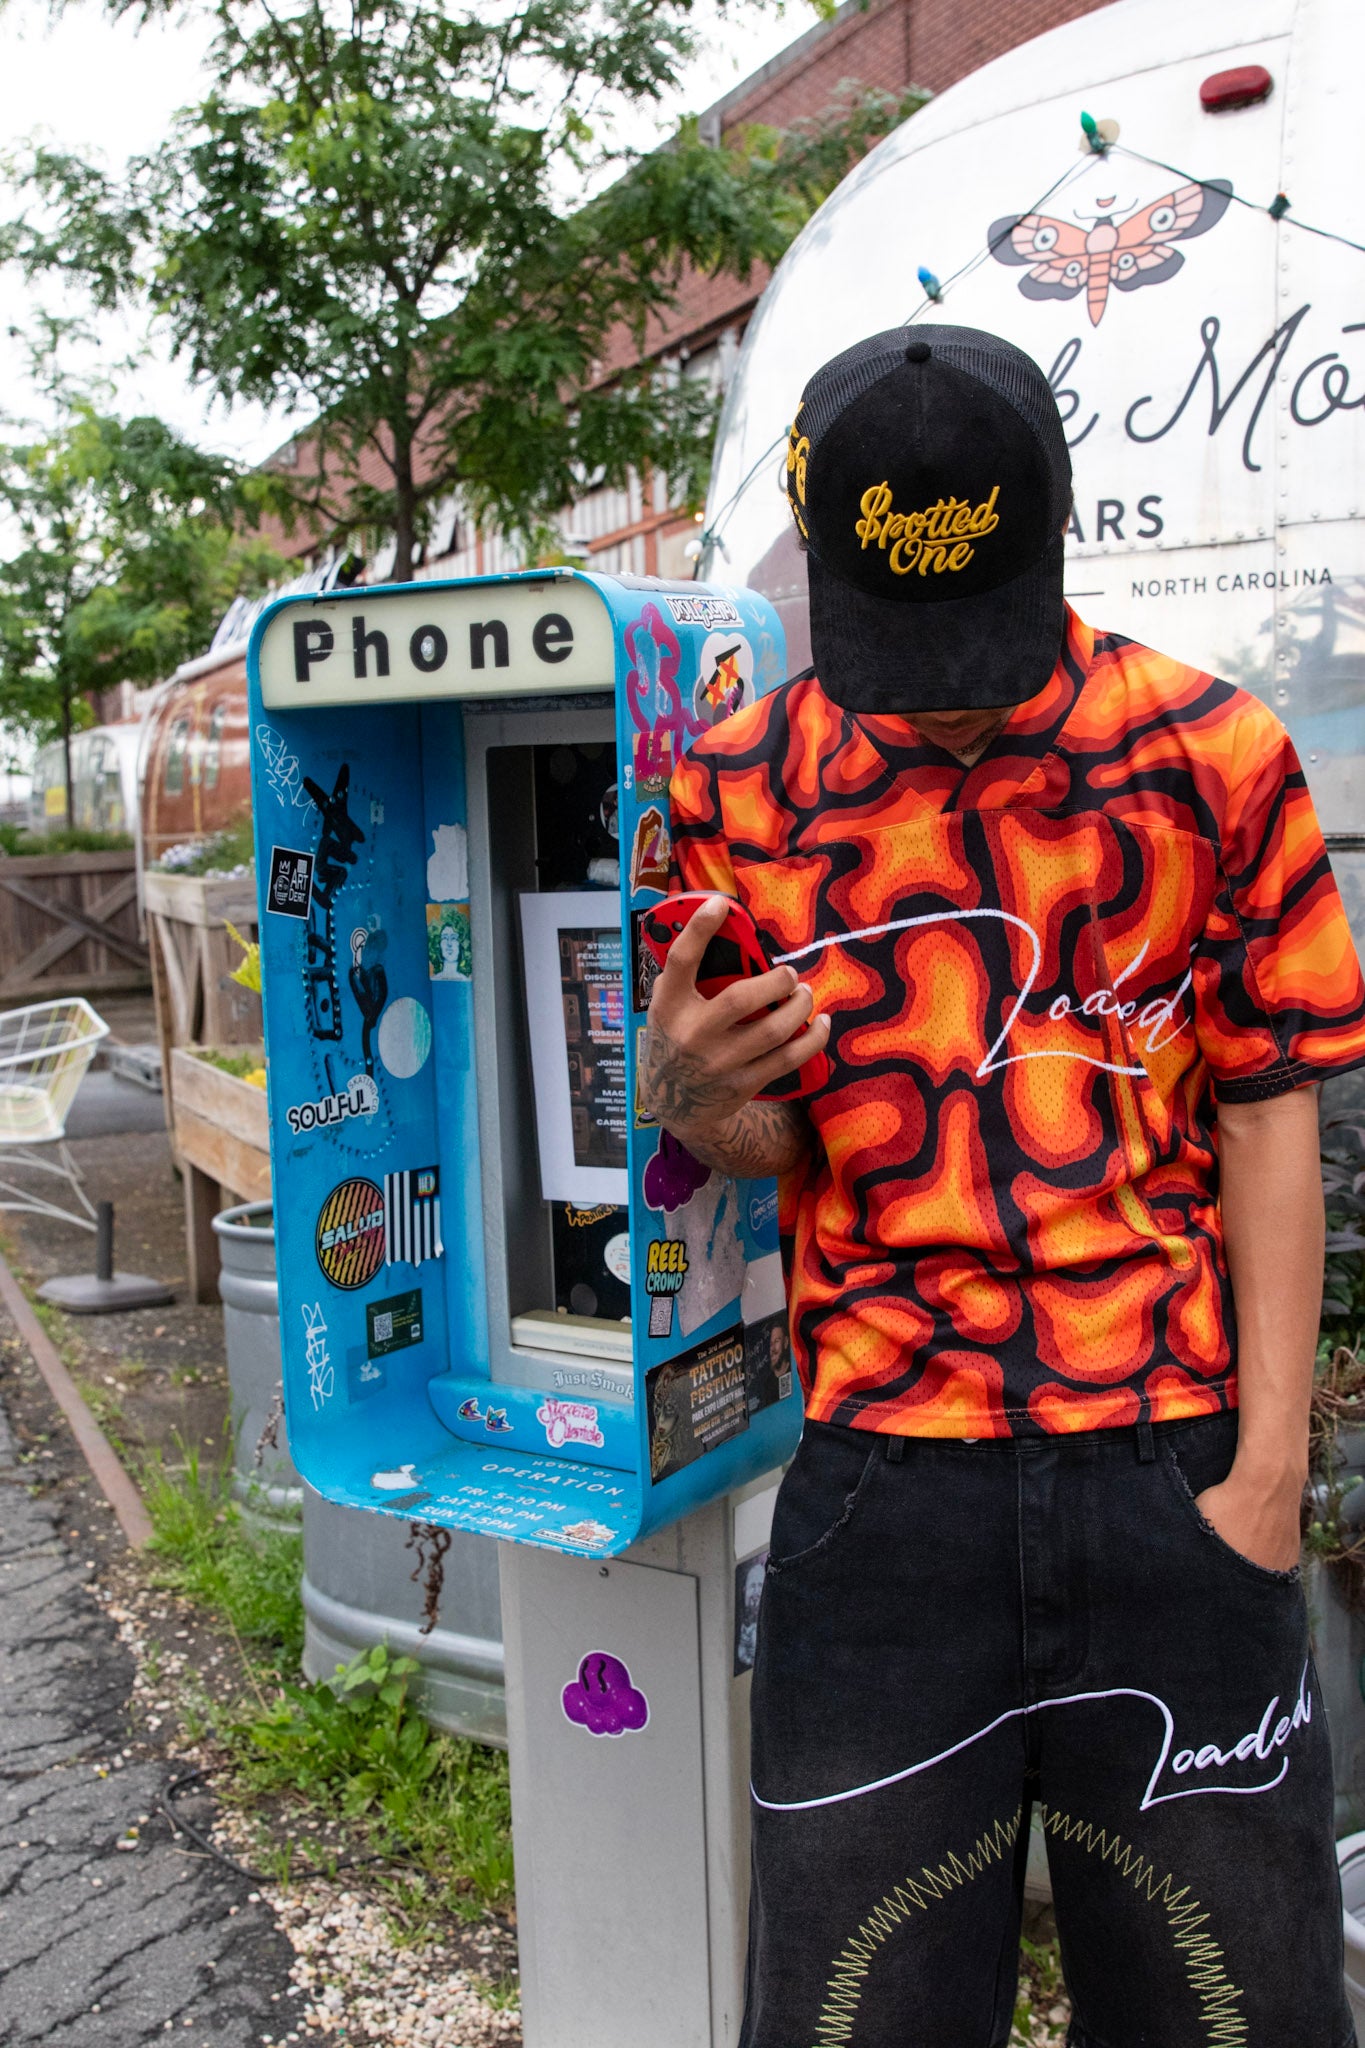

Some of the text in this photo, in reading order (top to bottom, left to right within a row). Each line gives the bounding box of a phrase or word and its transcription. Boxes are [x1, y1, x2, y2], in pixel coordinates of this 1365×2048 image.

[889, 537, 975, 576] One
[1132, 568, 1333, 598] NORTH CAROLINA
[293, 613, 574, 683] Phone
[290, 868, 309, 891] ART
[577, 952, 623, 960] FEILDS.W
[587, 942, 622, 950] STRAW
[602, 1089, 626, 1097] MAG
[288, 1089, 370, 1133] SOULFUL
[322, 1209, 384, 1251] SALUD
[648, 1242, 688, 1273] REEL
[647, 1272, 683, 1293] CROWD
[553, 1369, 588, 1388] Just
[689, 1344, 743, 1388] TATTOO
[690, 1366, 745, 1409] FESTIVAL
[481, 1463, 625, 1496] OPERATION
[532, 1460, 614, 1479] HOURS OF
[419, 1505, 458, 1518] SUN
[436, 1495, 471, 1506] SAT
[513, 1509, 545, 1521] PM
[458, 1485, 489, 1497] FRI
[536, 1502, 567, 1513] PM
